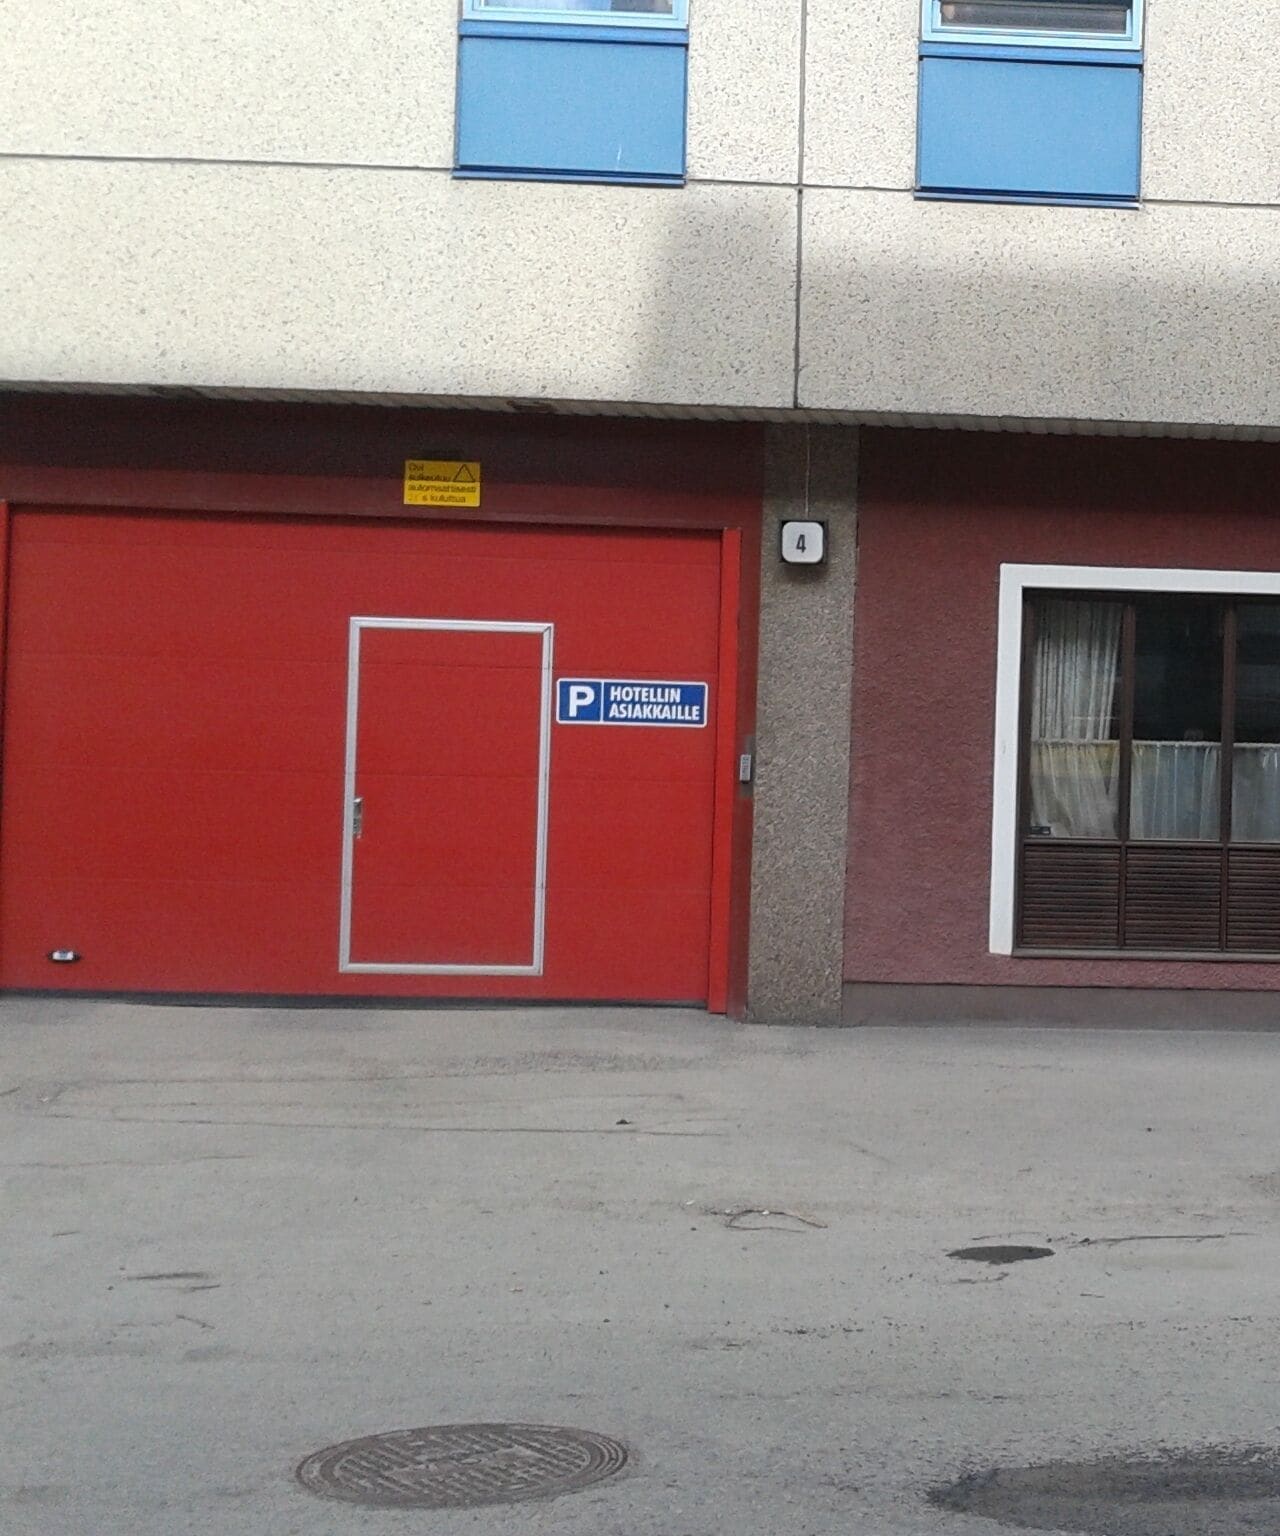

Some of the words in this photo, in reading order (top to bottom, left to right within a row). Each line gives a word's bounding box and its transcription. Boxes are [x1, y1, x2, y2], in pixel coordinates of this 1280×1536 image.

[796, 534, 807, 553] 4
[568, 685, 595, 718] P
[610, 686, 681, 703] HOTELLIN
[609, 704, 700, 721] ASIAKKAILLE
